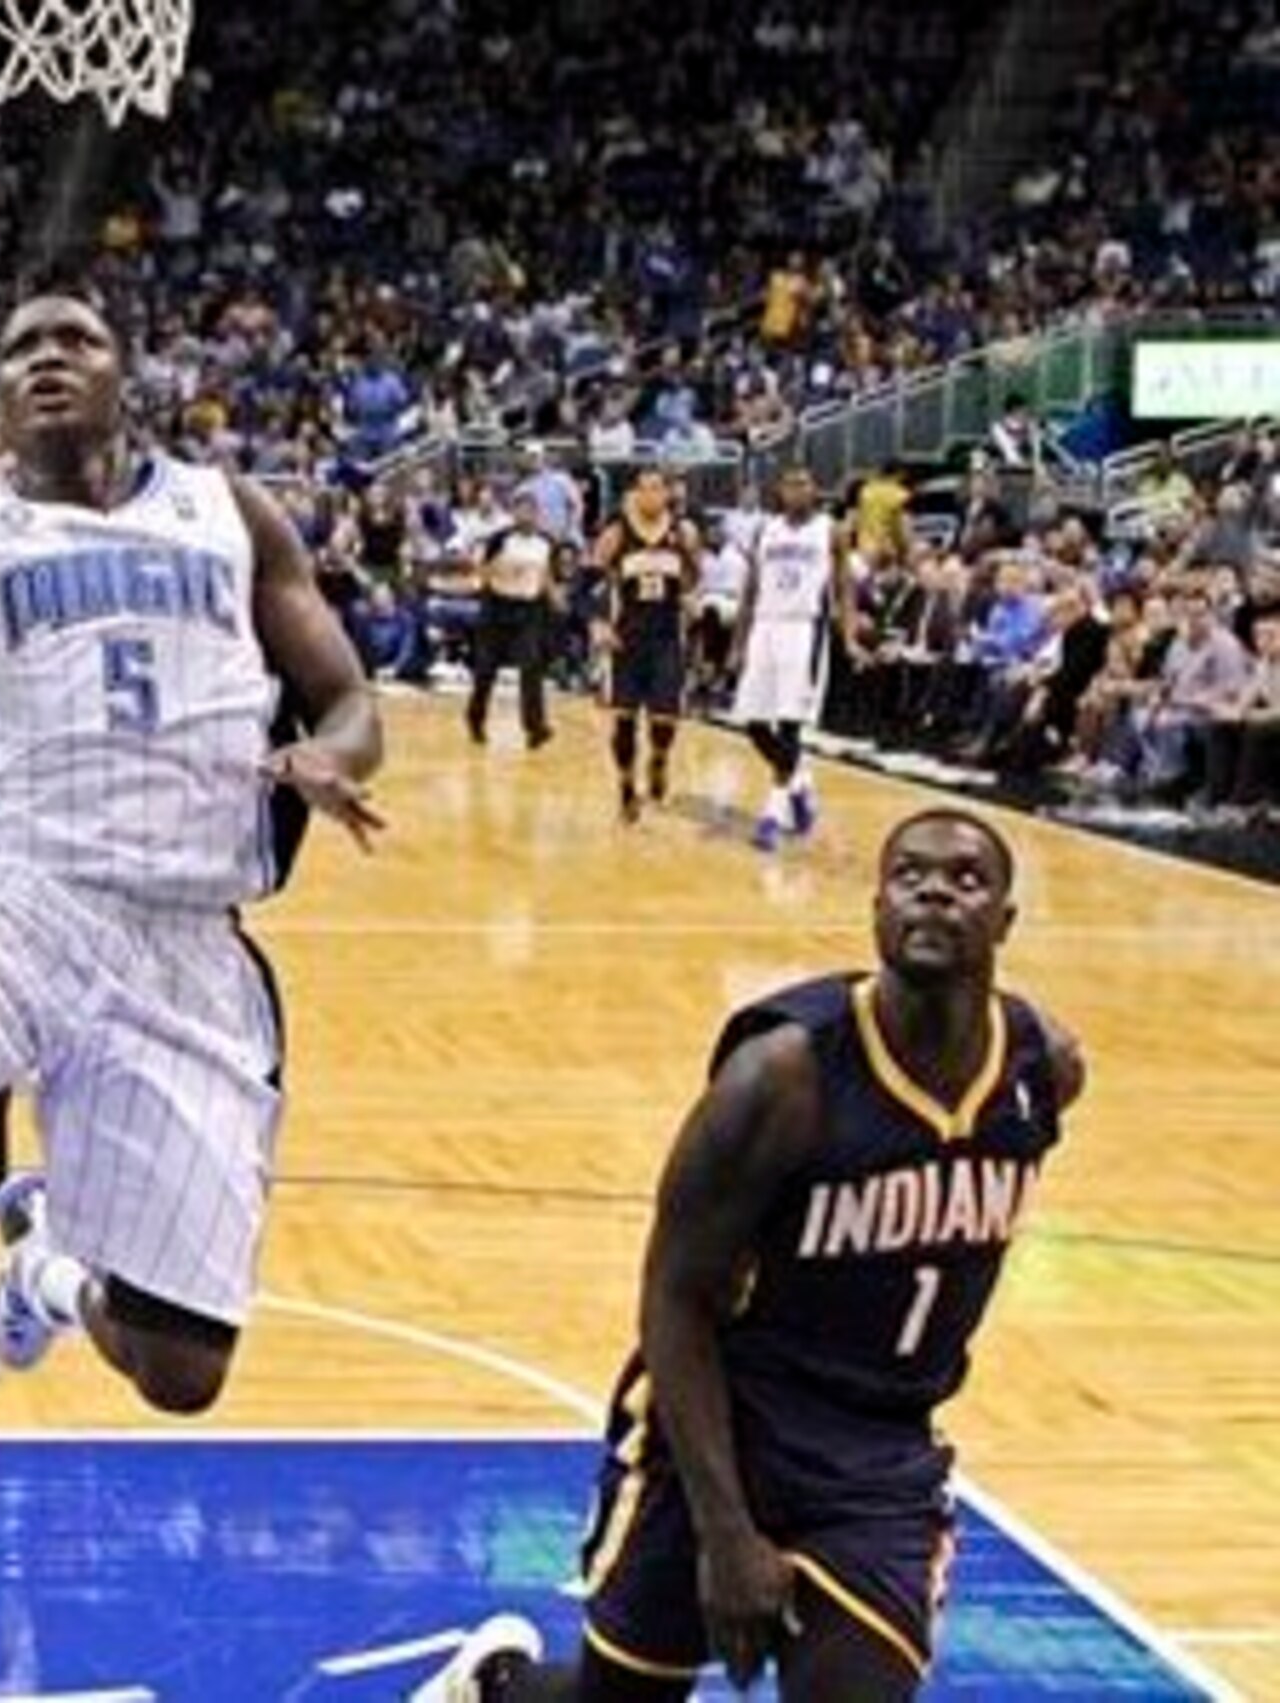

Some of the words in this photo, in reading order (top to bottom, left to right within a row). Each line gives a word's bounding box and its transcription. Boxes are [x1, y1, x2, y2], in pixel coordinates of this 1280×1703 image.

[0, 546, 239, 653] MAGIC
[102, 637, 159, 734] 5
[895, 1266, 940, 1356] 1
